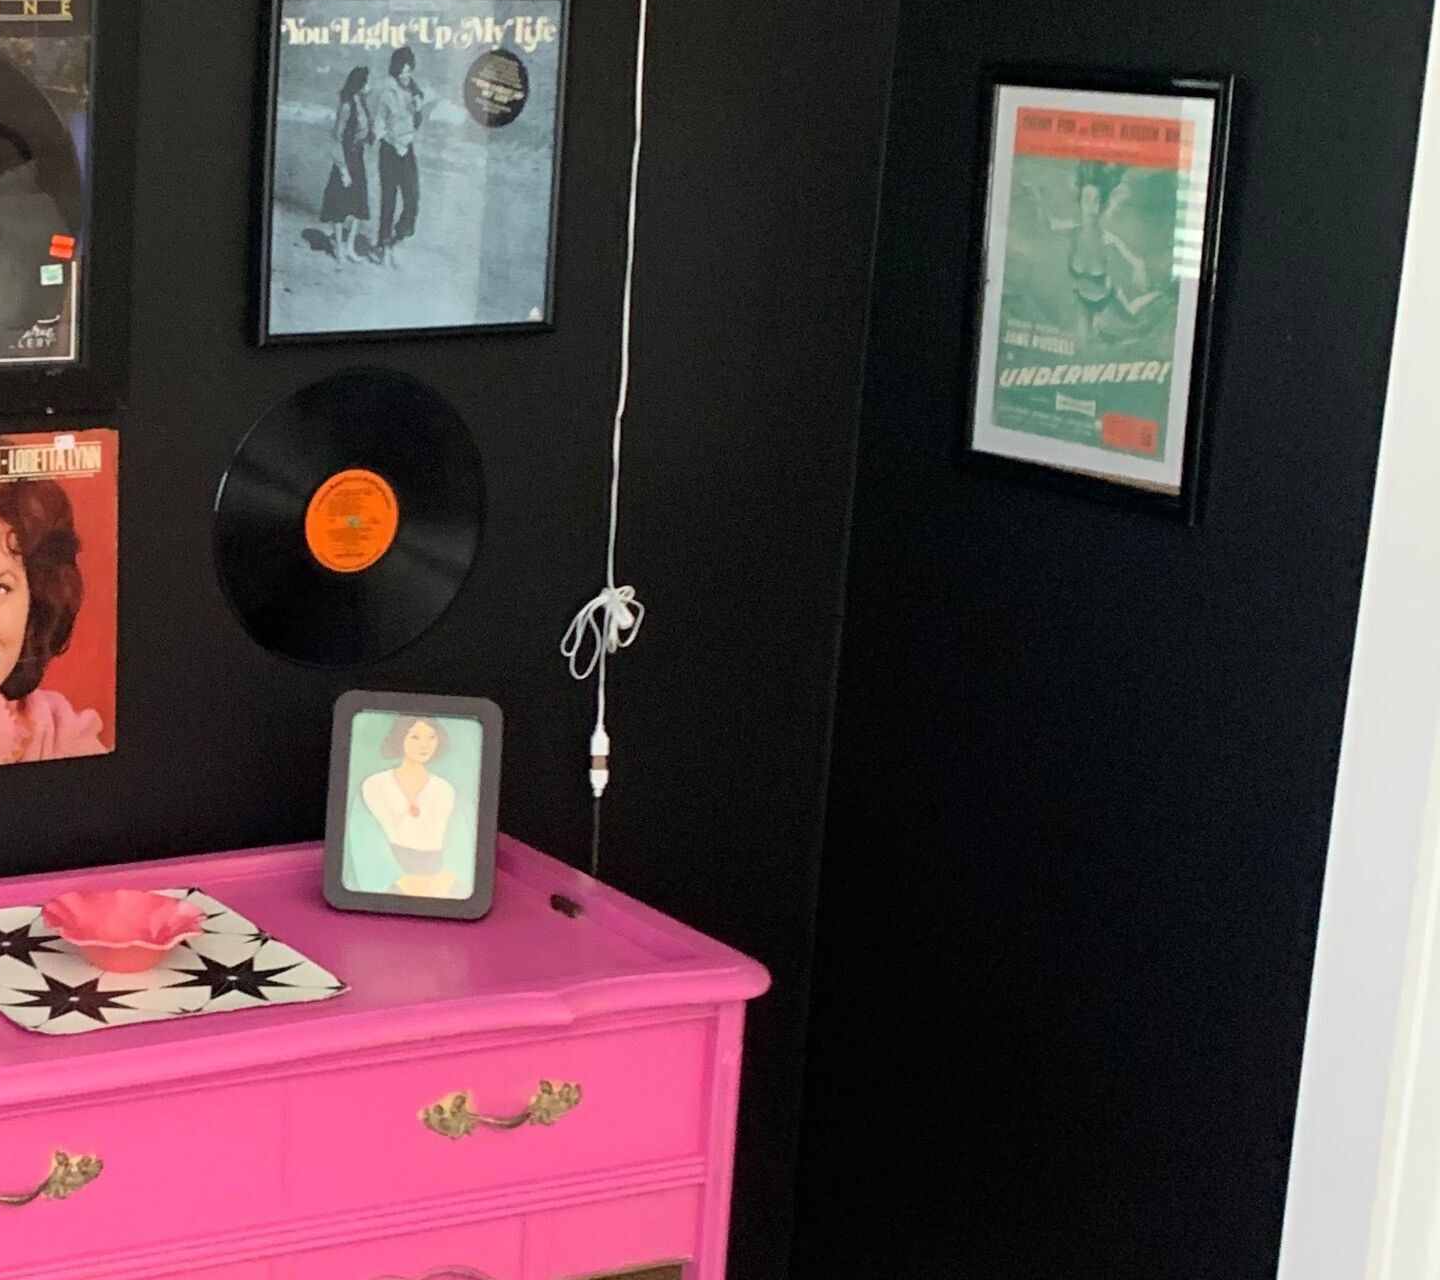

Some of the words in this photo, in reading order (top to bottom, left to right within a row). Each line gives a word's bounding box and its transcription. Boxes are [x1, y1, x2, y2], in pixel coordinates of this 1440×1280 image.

[281, 17, 330, 46] You
[330, 16, 409, 51] Light
[409, 16, 452, 50] Up
[453, 16, 513, 51] My
[9, 337, 54, 349] LERY
[998, 360, 1173, 388] UNDERWATER!
[8, 447, 66, 474] LORETTA
[67, 445, 102, 471] LYNN
